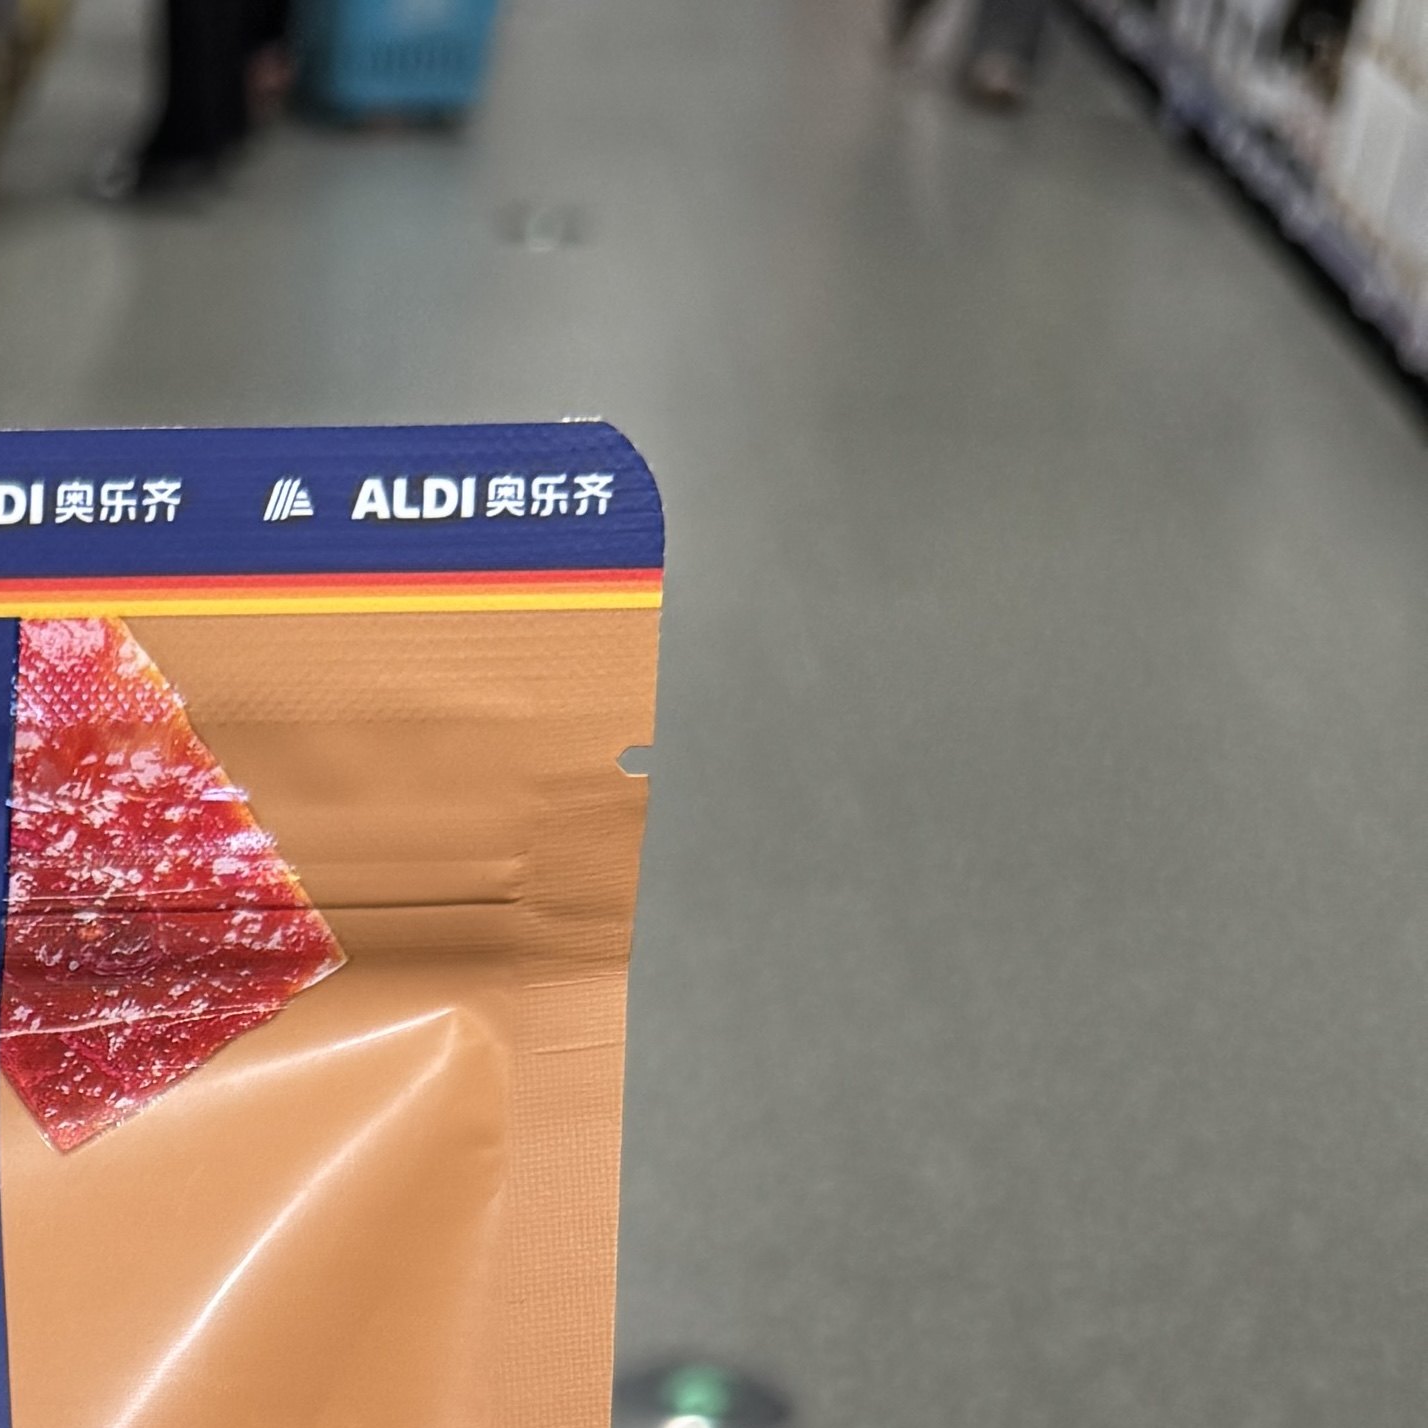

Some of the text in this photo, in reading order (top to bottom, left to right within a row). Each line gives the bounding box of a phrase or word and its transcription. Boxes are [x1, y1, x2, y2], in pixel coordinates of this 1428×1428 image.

[55, 479, 181, 523] 奥乐齐
[352, 473, 613, 519] ALDI 奥乐齐
